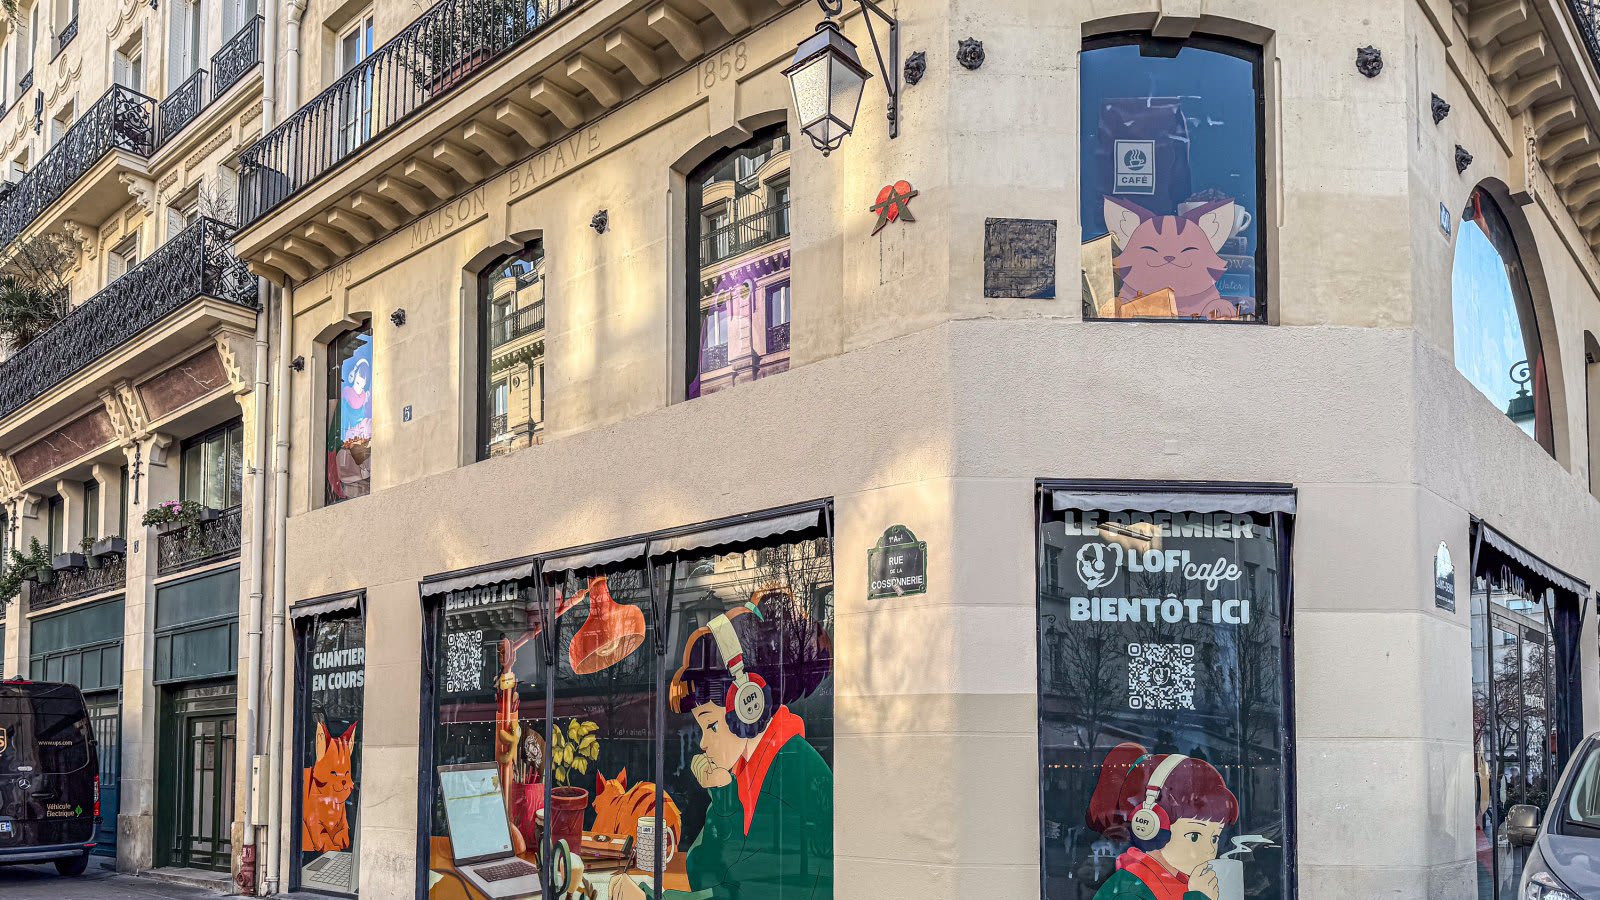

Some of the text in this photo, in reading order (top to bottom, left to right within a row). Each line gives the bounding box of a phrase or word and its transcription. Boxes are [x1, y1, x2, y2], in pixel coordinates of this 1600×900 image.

[696, 41, 748, 95] 1858
[411, 125, 601, 249] MAISON BATAVE
[1121, 175, 1148, 184] CAFÉ
[324, 261, 352, 294] 1795
[404, 406, 411, 421] 5
[1064, 511, 1254, 539] LE PREMIER
[889, 555, 903, 565] RUE
[1128, 549, 1242, 591] LOFI cafe
[501, 582, 518, 602] ICI
[871, 575, 923, 589] COSSONNERIE
[1069, 593, 1250, 624] BIENTÔT ICI
[312, 647, 365, 670] CHANTIER
[312, 669, 364, 692] EN COURS
[743, 692, 757, 705] LOFI
[1135, 817, 1149, 825] LOFI
